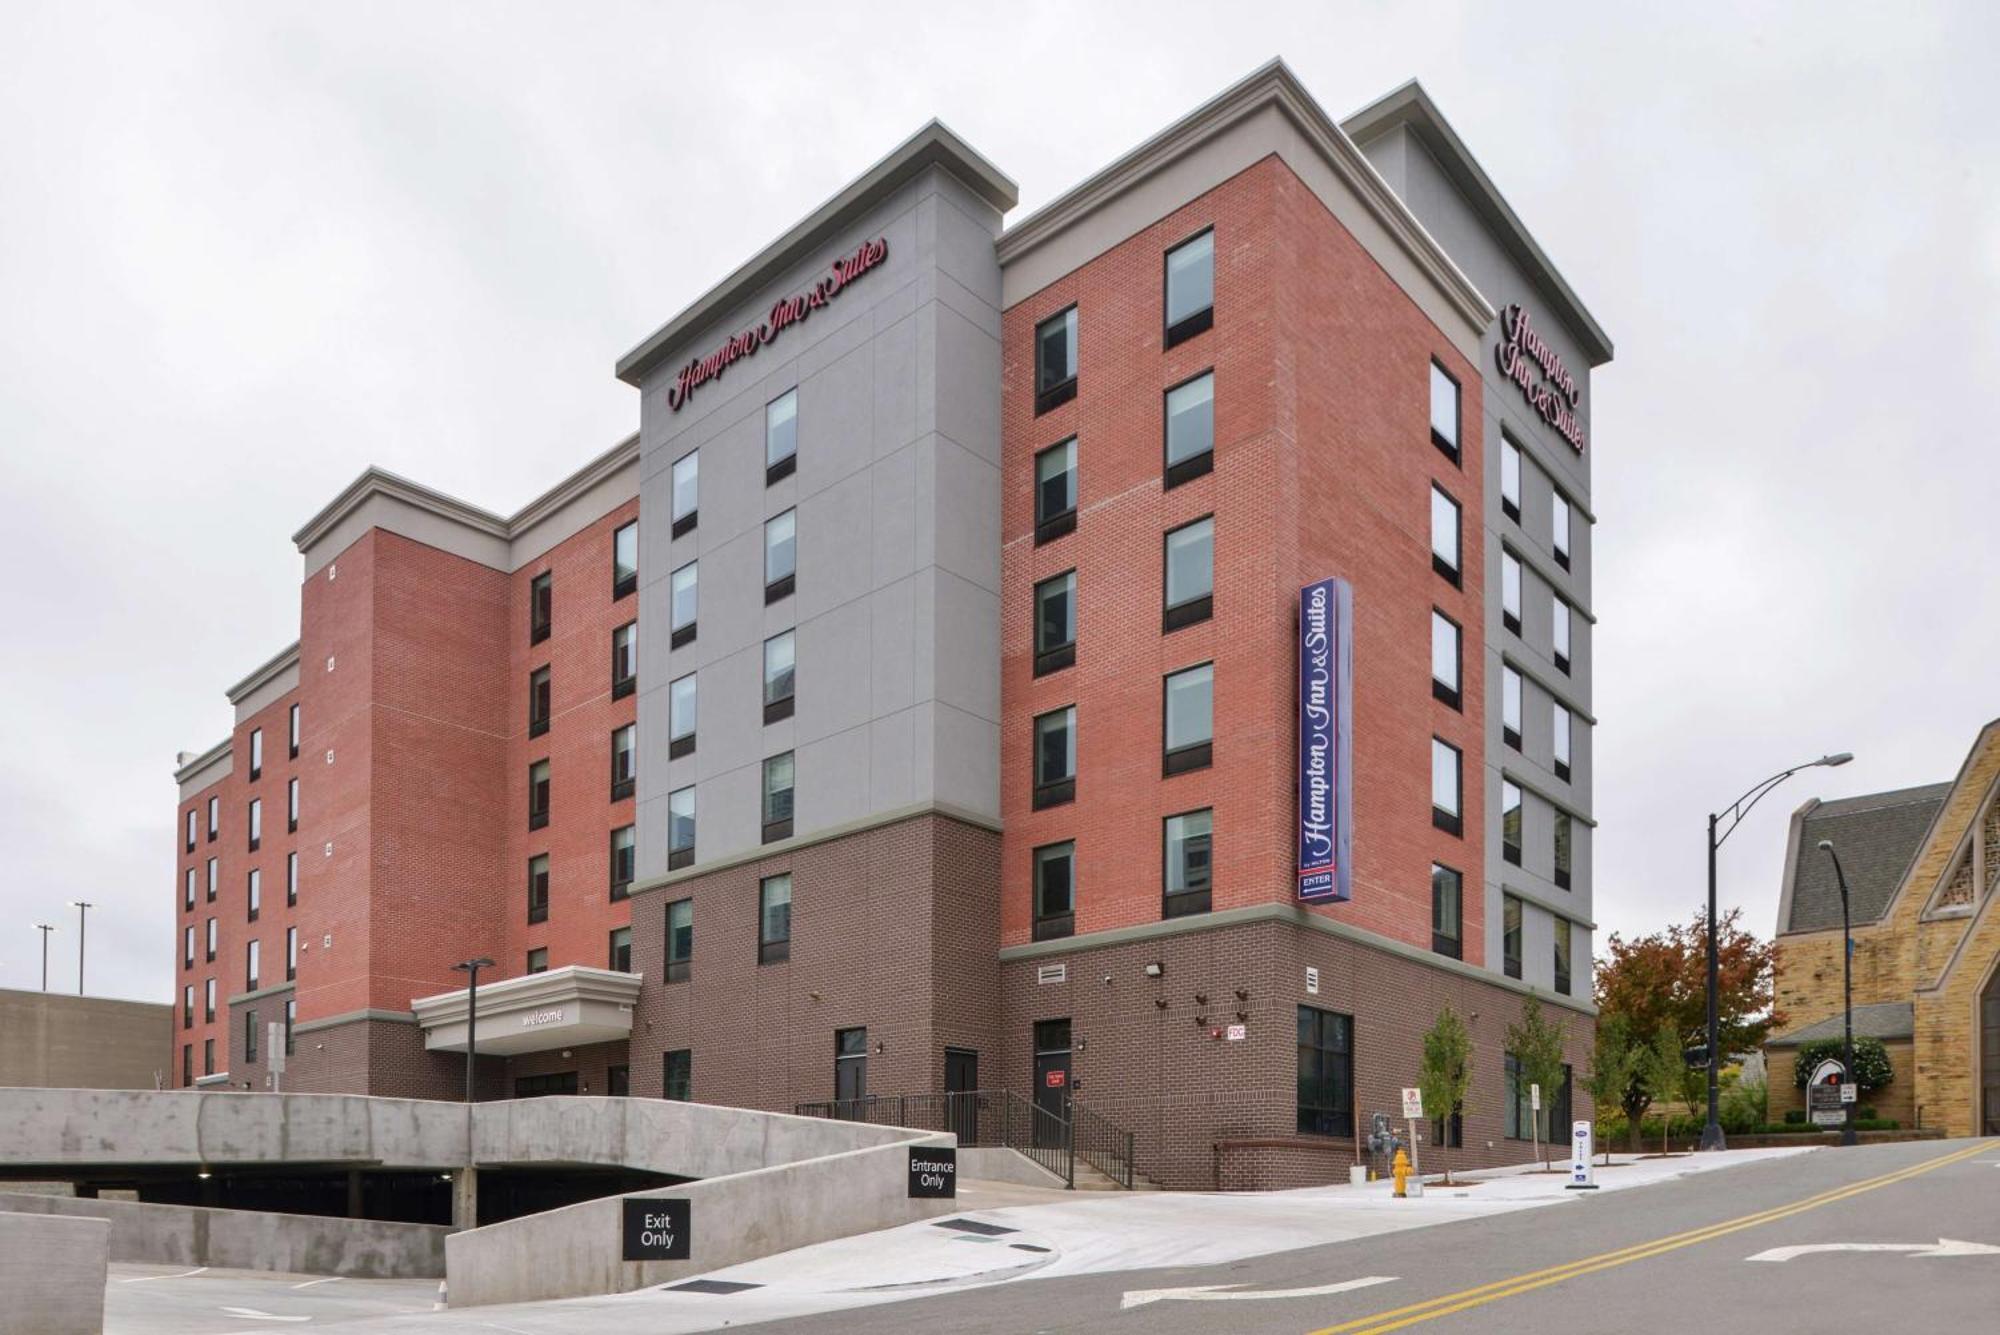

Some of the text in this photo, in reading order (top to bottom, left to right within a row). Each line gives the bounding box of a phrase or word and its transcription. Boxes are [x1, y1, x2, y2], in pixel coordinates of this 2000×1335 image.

[668, 236, 888, 411] Hampton Inn & Suites
[1501, 303, 1580, 409] Hampton
[1497, 342, 1540, 406] Inn
[1303, 586, 1332, 857] Hampton Inn & Suites
[1303, 874, 1331, 886] ENTER
[522, 1009, 564, 1026] welcome
[911, 1158, 954, 1173] Entrance
[921, 1174, 945, 1190] Only
[645, 1214, 671, 1229] Exit
[641, 1230, 674, 1249] Only
